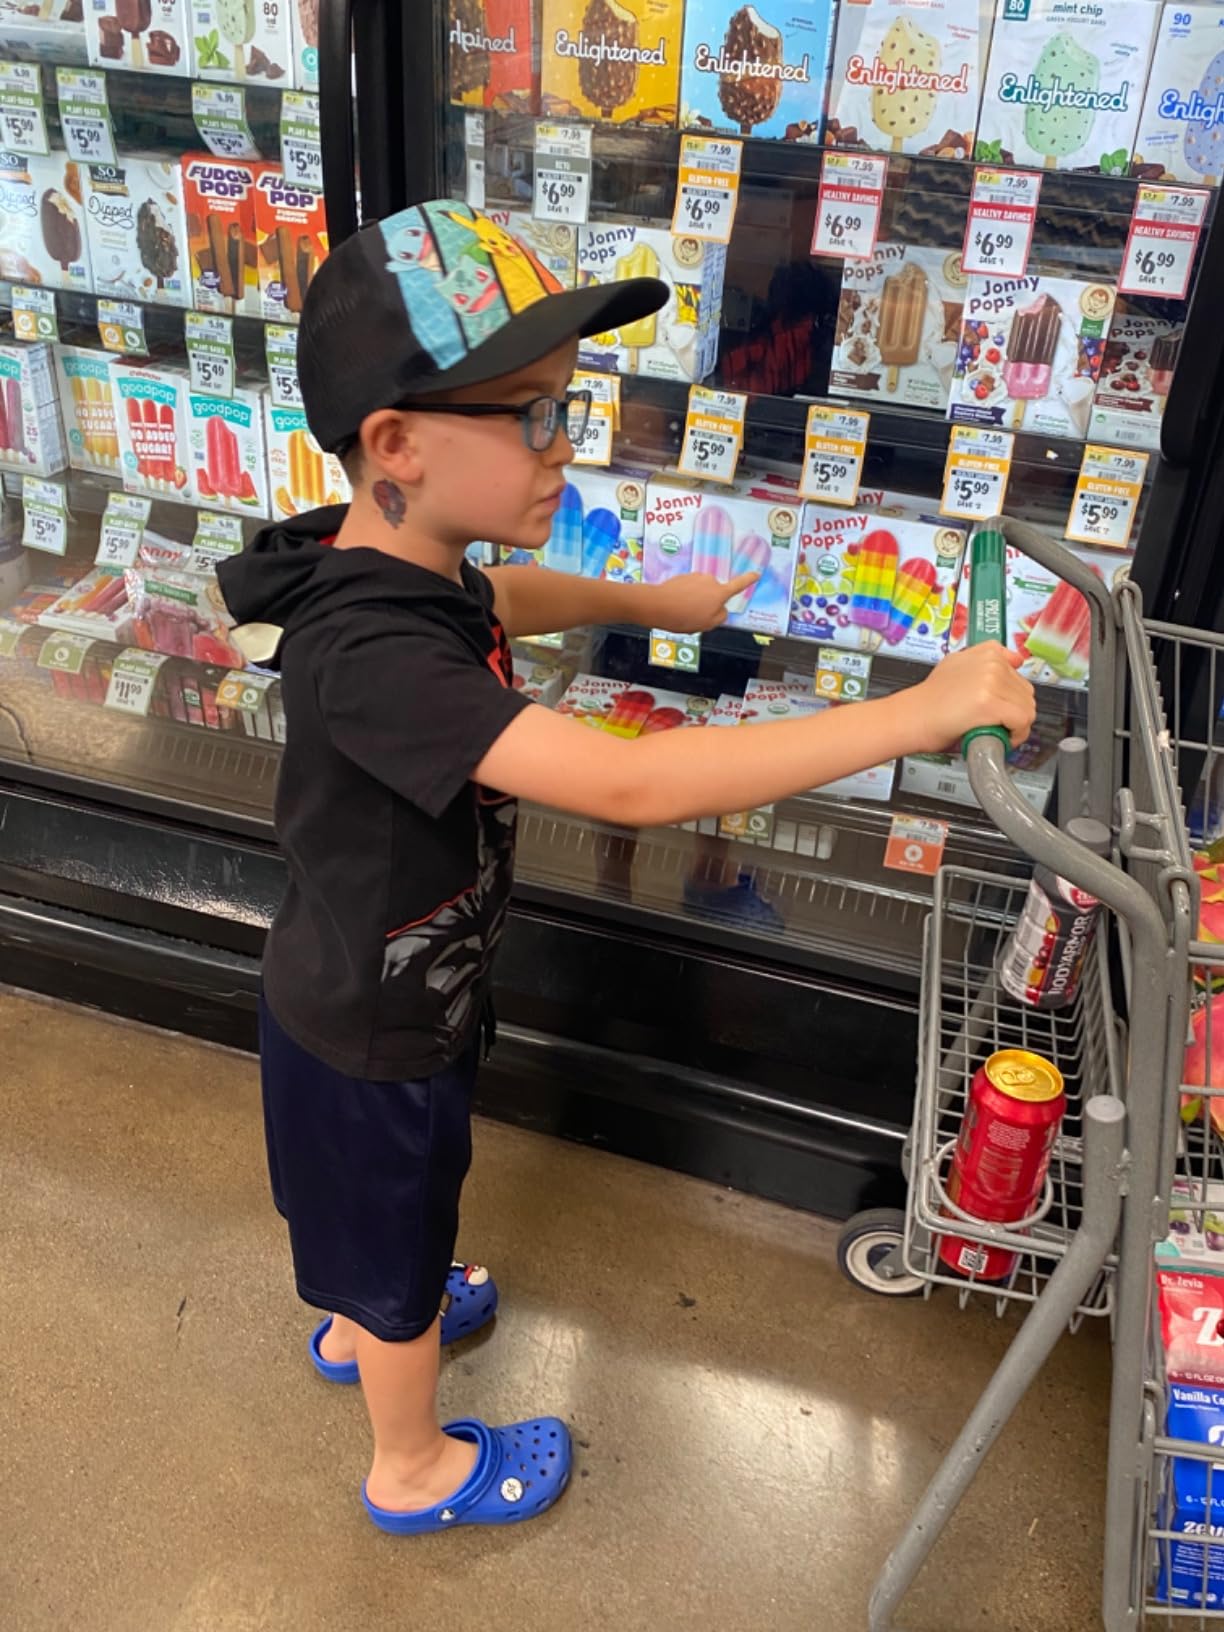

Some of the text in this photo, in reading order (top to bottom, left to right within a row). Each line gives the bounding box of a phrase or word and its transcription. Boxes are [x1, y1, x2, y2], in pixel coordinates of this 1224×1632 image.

[1080, 4, 1103, 17] chip
[1173, 13, 1192, 26] 90
[555, 30, 667, 66] Enlightened
[695, 43, 810, 82] Enlightened
[846, 55, 969, 95] Enlightened
[999, 72, 1129, 113] Enlightened
[1159, 88, 1224, 130] Enligh
[189, 166, 253, 186] FUDGY
[200, 180, 244, 197] POP
[270, 191, 314, 208] POP
[88, 195, 135, 230] Dipped
[588, 227, 636, 248] Jonny
[983, 276, 1040, 297] Jonny
[1123, 318, 1178, 330] Jonny
[121, 383, 175, 402] goodpop
[193, 402, 249, 422] goodpop
[655, 494, 703, 511] Jonny
[813, 515, 869, 533] Jonny
[582, 679, 633, 690] Jonny
[757, 683, 809, 692] Jonny
[1172, 1388, 1224, 1406] Vanilla Co
